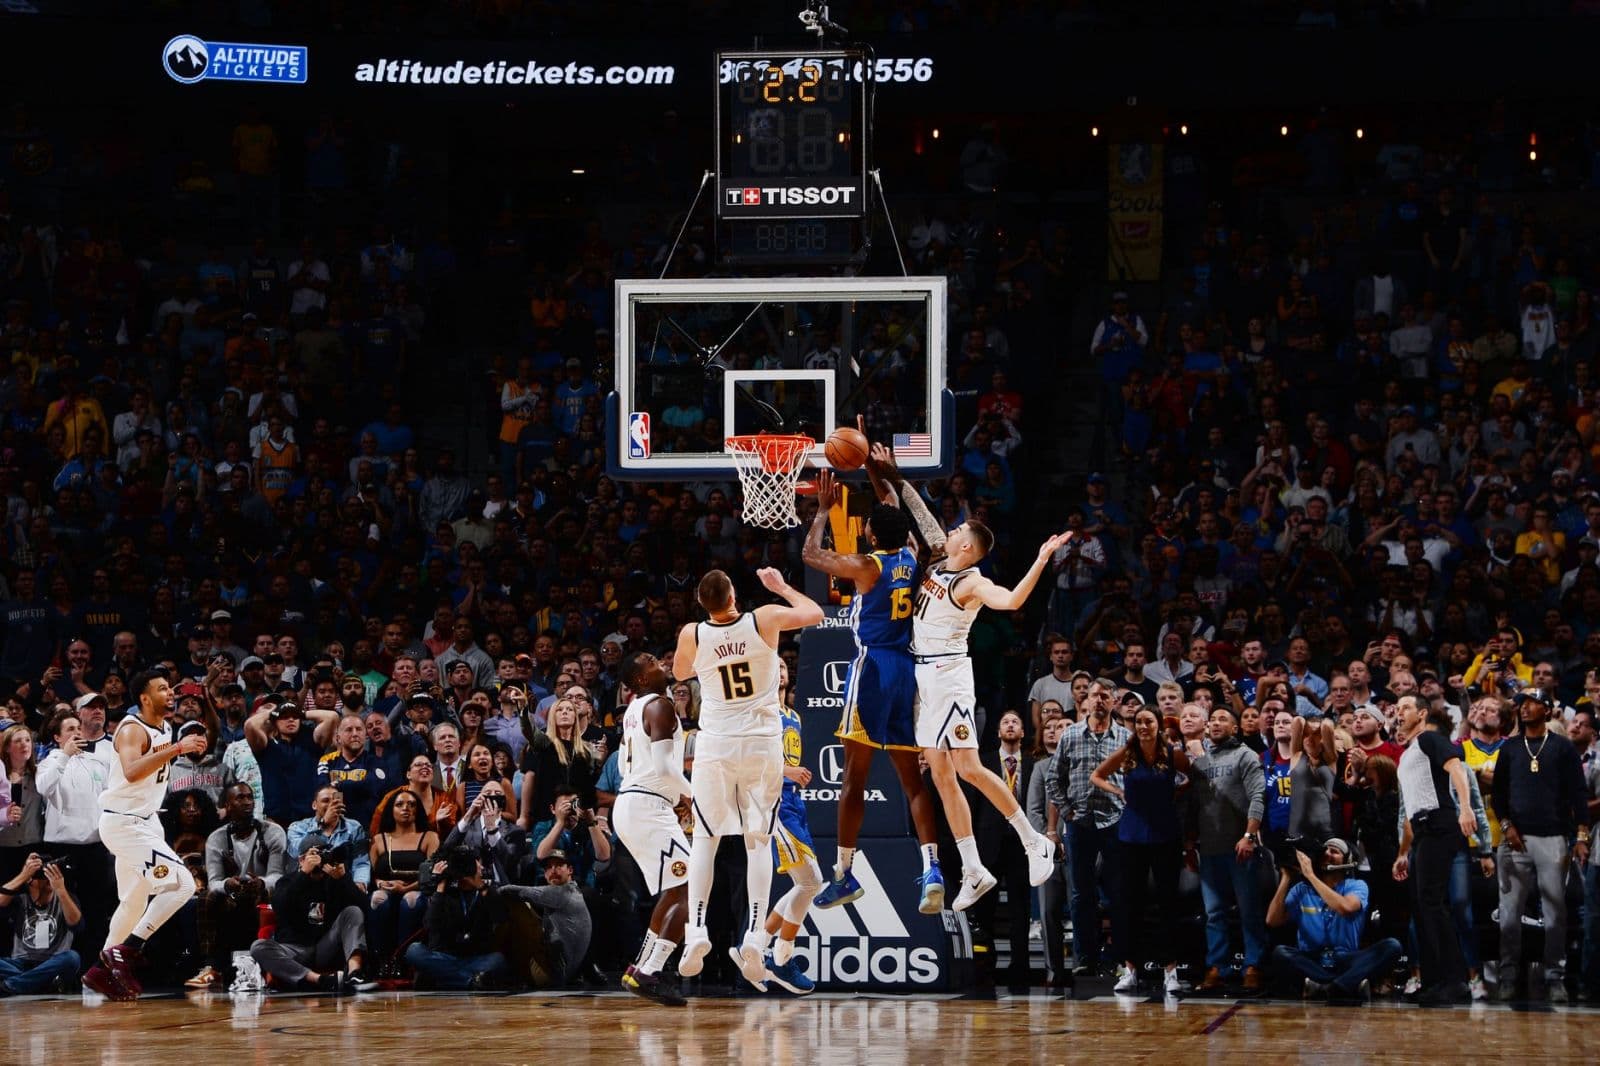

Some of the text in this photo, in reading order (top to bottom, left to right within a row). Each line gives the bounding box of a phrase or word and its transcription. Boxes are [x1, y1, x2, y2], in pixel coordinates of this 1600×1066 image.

[214, 47, 301, 66] ALTITUDE
[212, 63, 299, 79] TICKETS
[354, 59, 675, 85] altitudetickets.com
[763, 66, 820, 102] 2.2
[762, 187, 856, 205] TISSOT
[890, 587, 913, 622] 15
[714, 641, 747, 660] JOKIĆ
[718, 661, 754, 701] 15
[172, 777, 193, 792] OHIO
[1276, 795, 1291, 805] CIT
[792, 936, 940, 984] didas
